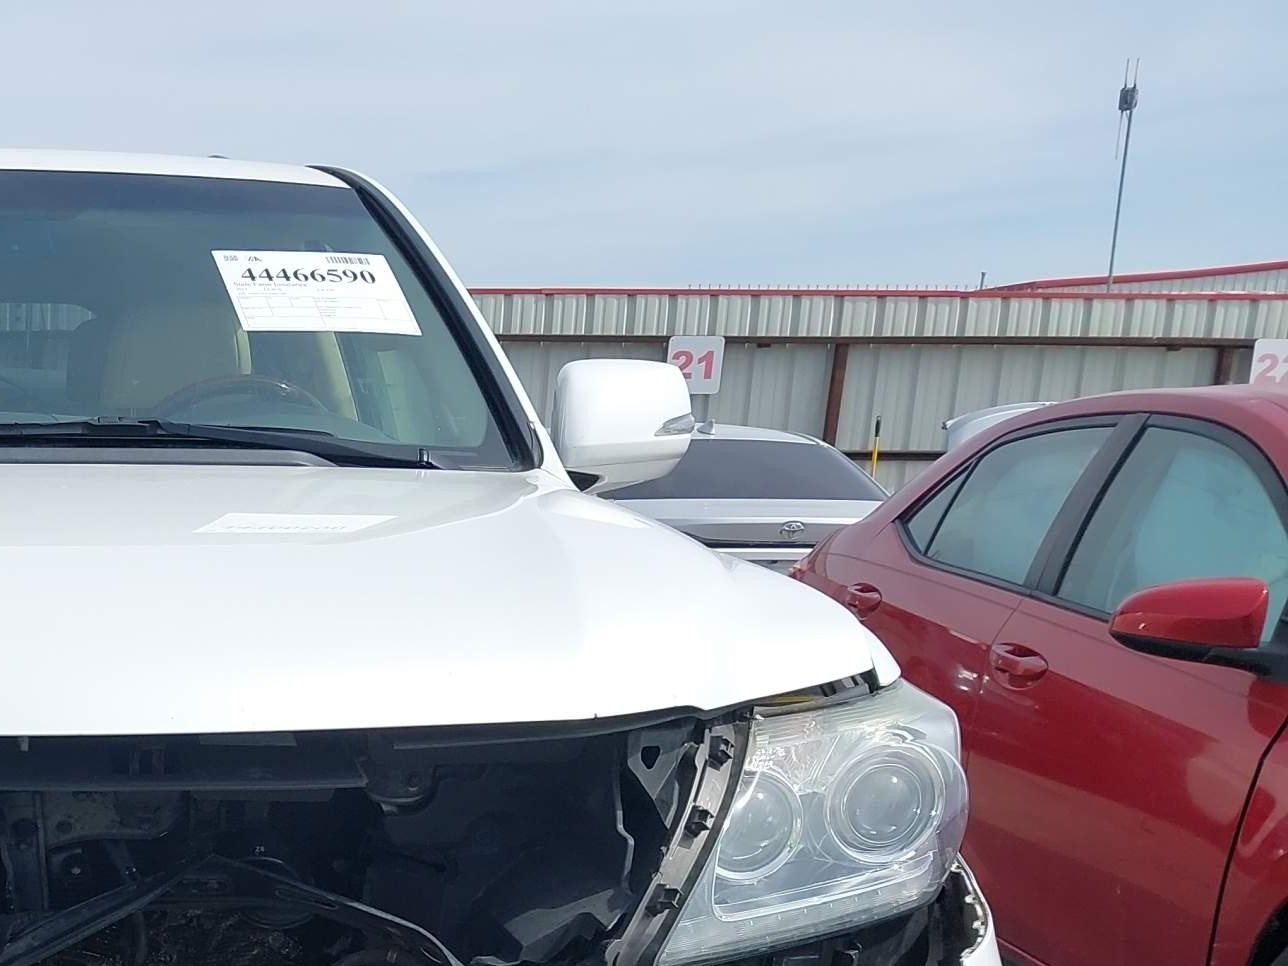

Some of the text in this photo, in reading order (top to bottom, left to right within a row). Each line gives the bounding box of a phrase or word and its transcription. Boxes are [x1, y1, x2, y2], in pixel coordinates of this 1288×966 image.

[241, 267, 376, 284] 44466590
[672, 350, 715, 380] 21
[1254, 352, 1288, 385] 2
